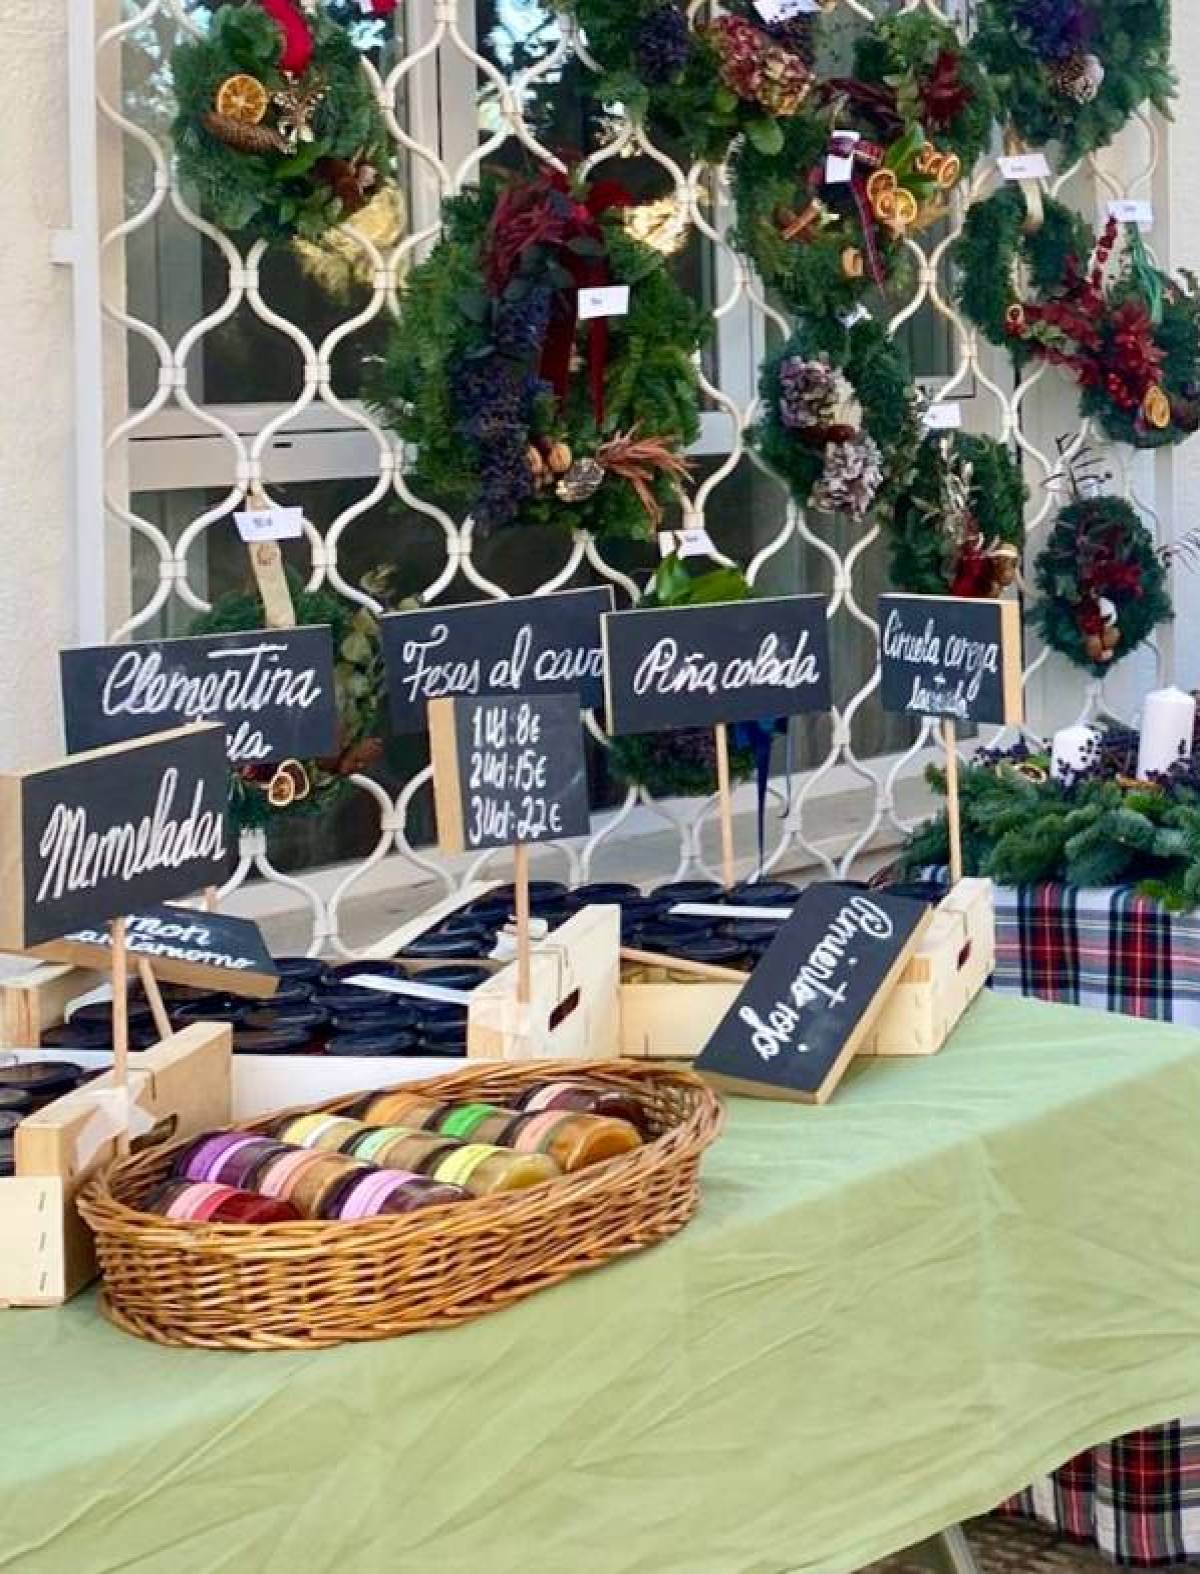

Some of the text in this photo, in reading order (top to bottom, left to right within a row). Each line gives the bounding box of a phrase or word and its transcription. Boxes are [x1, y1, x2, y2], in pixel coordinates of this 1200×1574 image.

[102, 643, 322, 717] Clementina
[488, 624, 532, 689] al
[633, 630, 821, 695] Piña colada
[36, 767, 228, 903] Mermeladas
[790, 895, 893, 1008] Pimiento
